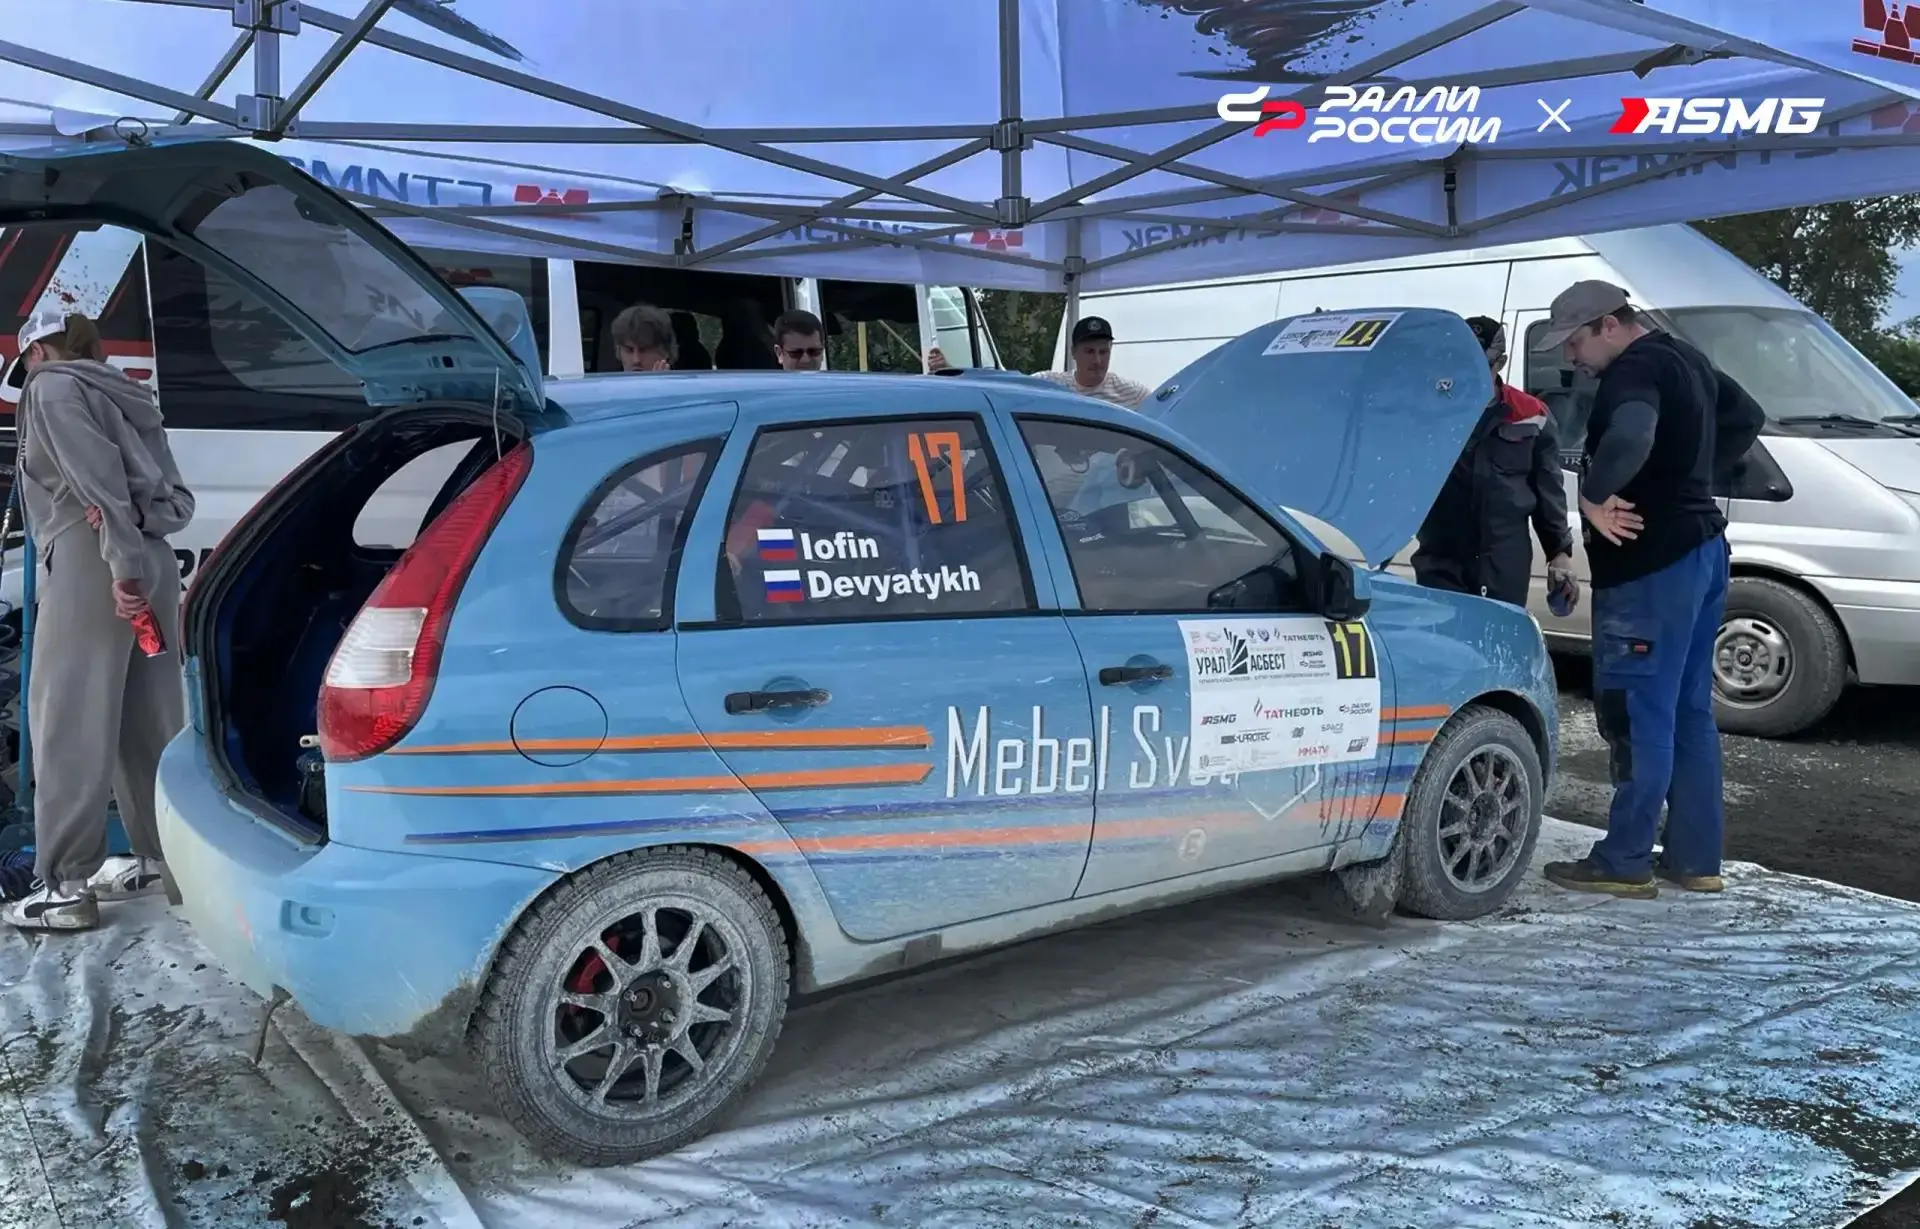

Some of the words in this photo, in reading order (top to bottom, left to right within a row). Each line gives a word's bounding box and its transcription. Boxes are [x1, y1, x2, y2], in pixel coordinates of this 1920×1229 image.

[1335, 322, 1382, 346] 17
[907, 431, 967, 525] 17
[802, 530, 879, 561] Iofin
[808, 565, 981, 603] Devyatykh
[1195, 656, 1227, 676] УРАЛ
[1250, 653, 1286, 671] АСБЕСТ
[1333, 622, 1367, 677] 17
[1203, 713, 1237, 726] ASMG
[1263, 707, 1325, 720] ТАТНЕФТЬ
[946, 704, 1109, 797] Mebel
